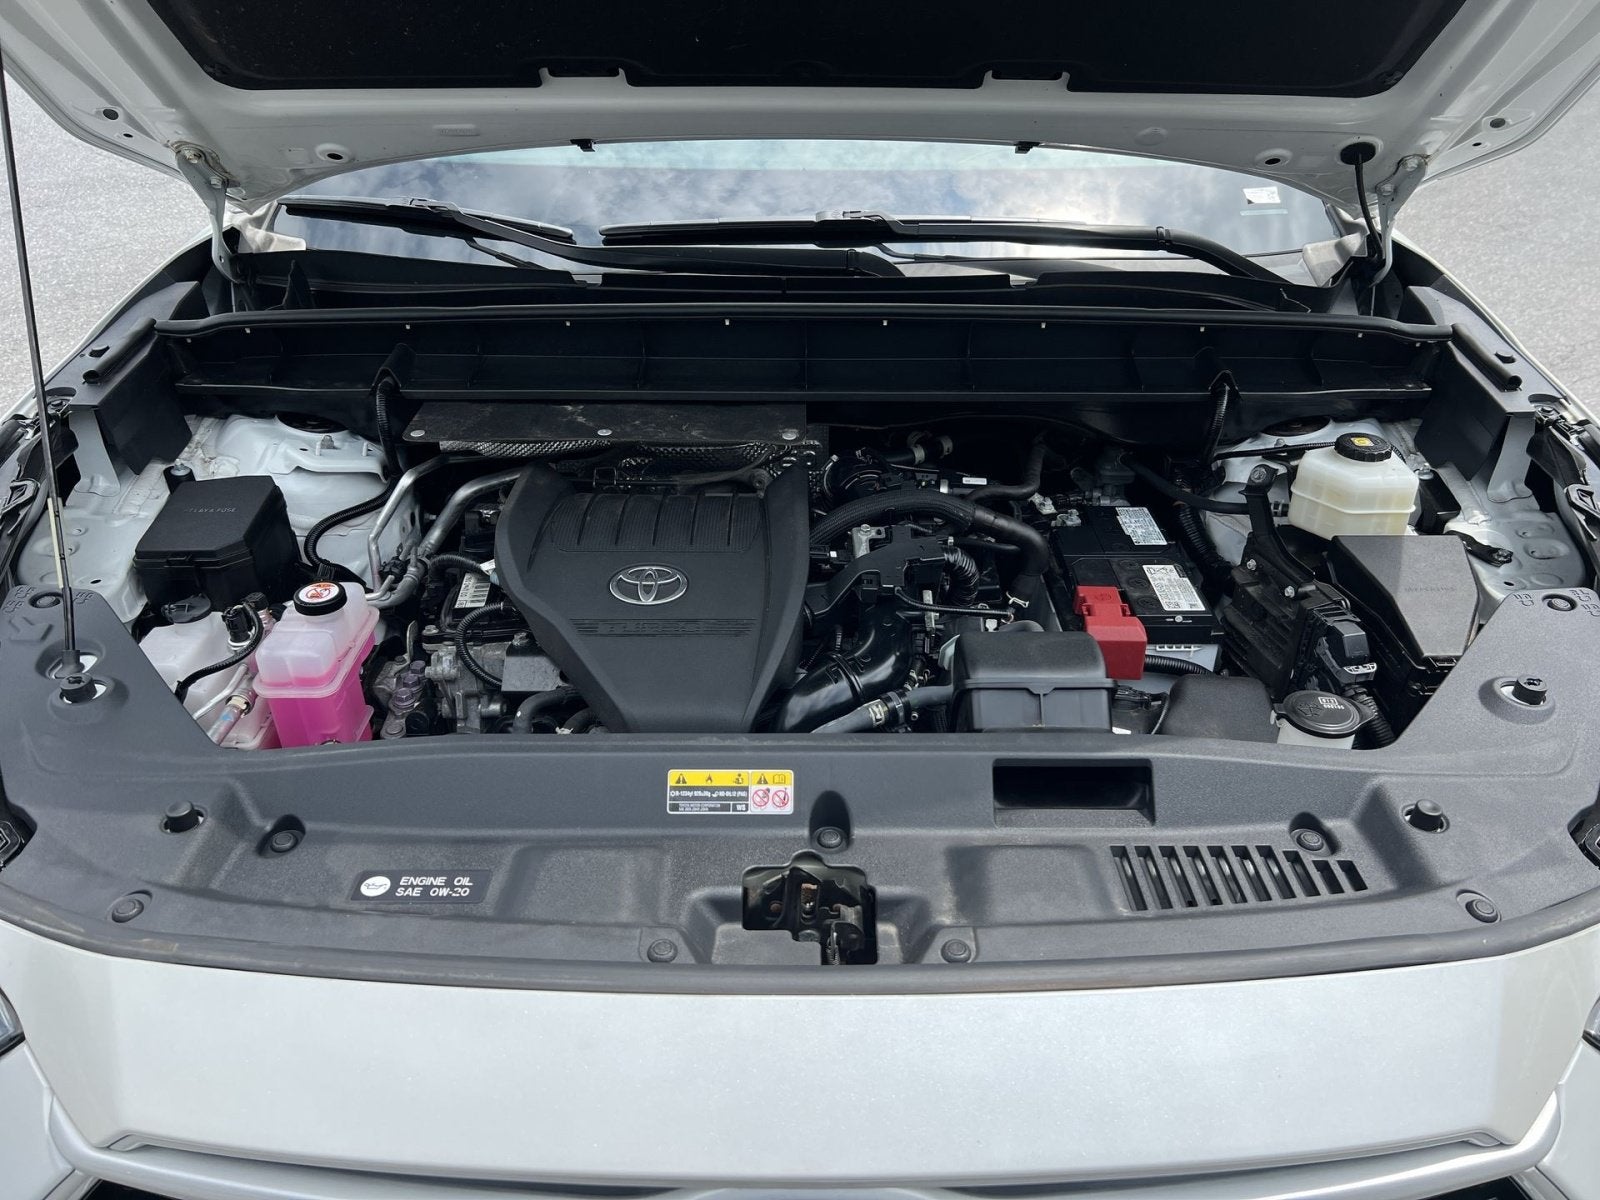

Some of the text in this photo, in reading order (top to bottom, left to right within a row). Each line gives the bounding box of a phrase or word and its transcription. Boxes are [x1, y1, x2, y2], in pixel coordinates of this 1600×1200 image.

[399, 876, 473, 886] ENGINE OIL
[395, 887, 470, 897] SAE 0W-20
